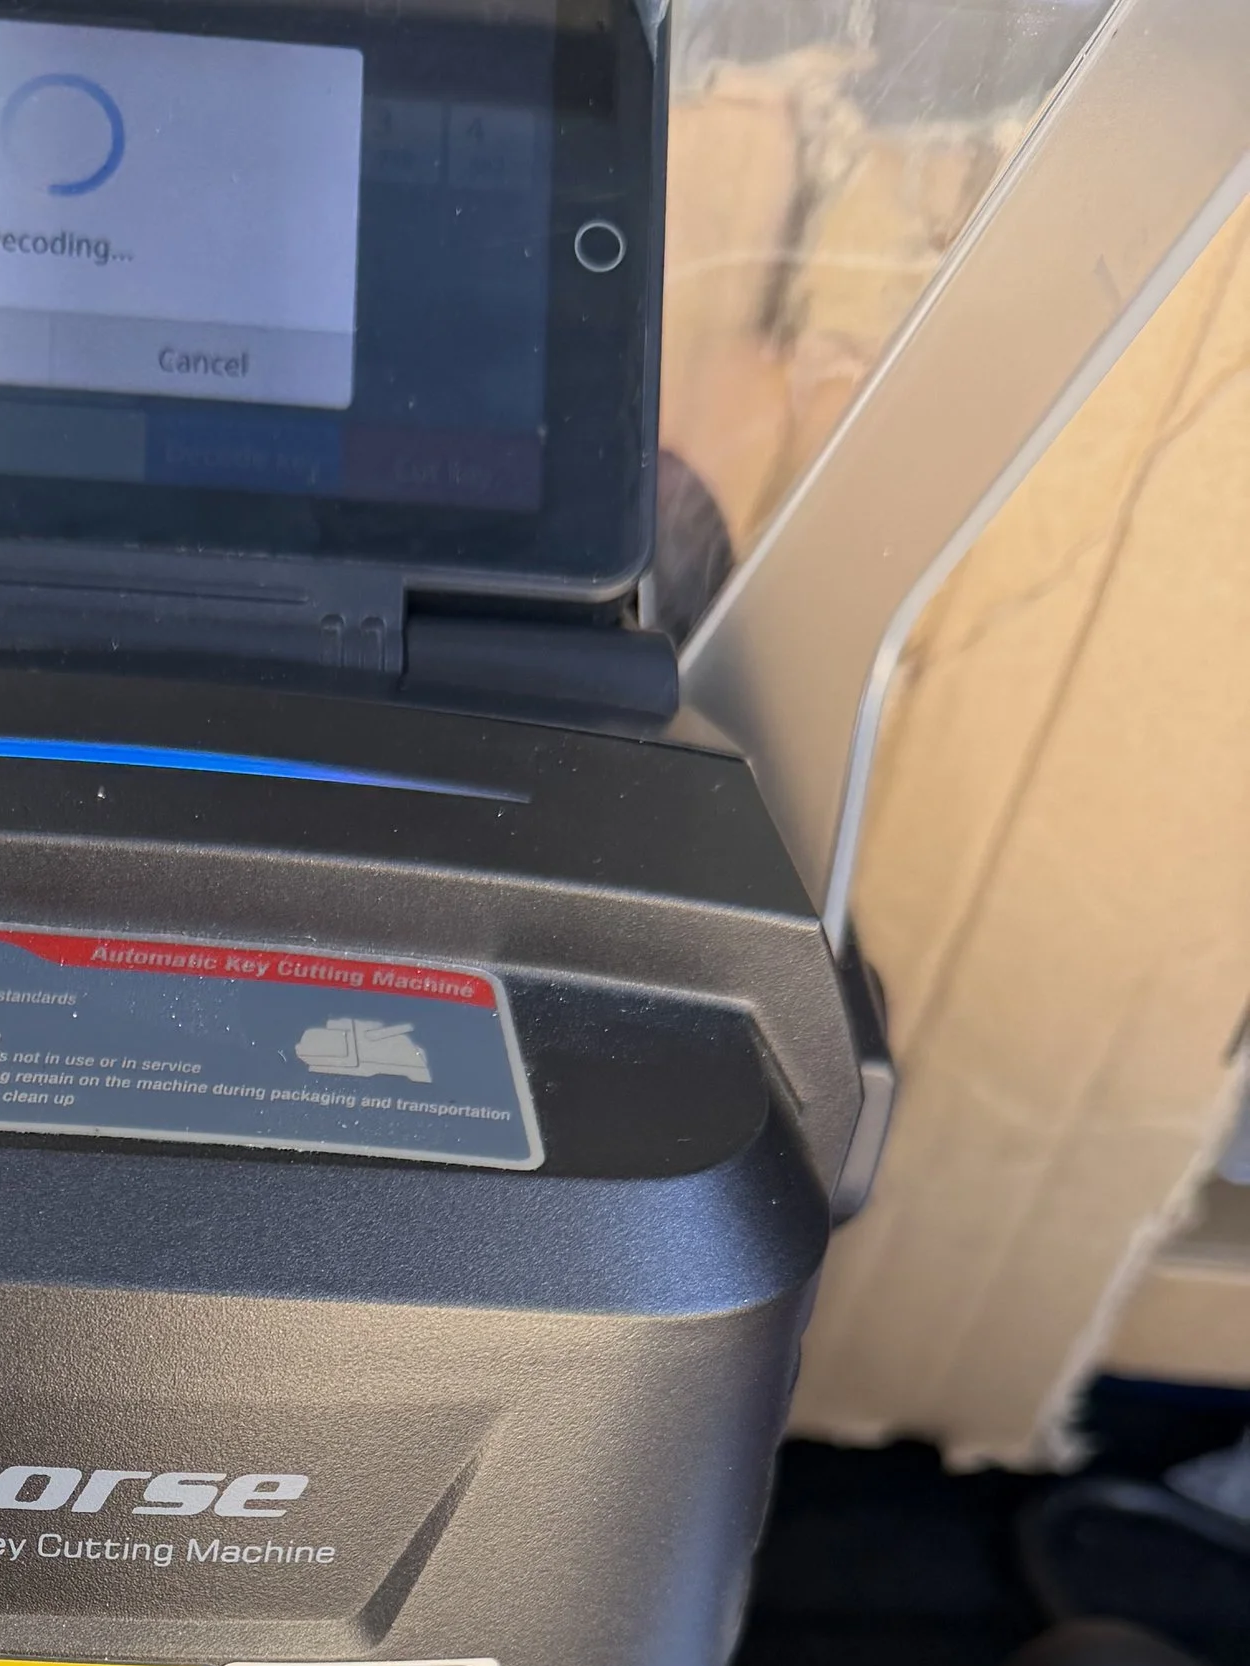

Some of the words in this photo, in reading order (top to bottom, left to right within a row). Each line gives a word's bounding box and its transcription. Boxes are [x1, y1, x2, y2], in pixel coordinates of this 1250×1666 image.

[159, 346, 249, 378] Cancel
[90, 946, 218, 970] Automatic
[224, 954, 271, 977] Key
[277, 959, 365, 987] Cutting
[372, 970, 475, 998] Machine
[12, 1051, 42, 1064] not
[45, 1052, 60, 1065] in
[65, 1055, 95, 1067] use
[100, 1057, 116, 1068] or
[121, 1056, 137, 1070] in
[141, 1059, 202, 1074] service
[2, 1089, 48, 1104] clean
[53, 1093, 75, 1107] up
[15, 1071, 75, 1085] remain
[79, 1075, 100, 1087] on
[105, 1075, 131, 1089] the
[136, 1078, 208, 1093] machine
[212, 1083, 266, 1100] during
[270, 1086, 357, 1108] packaging
[361, 1096, 392, 1109] and
[397, 1098, 511, 1121] transportation
[37, 1532, 172, 1568] Cutting
[187, 1538, 336, 1565] Machine
